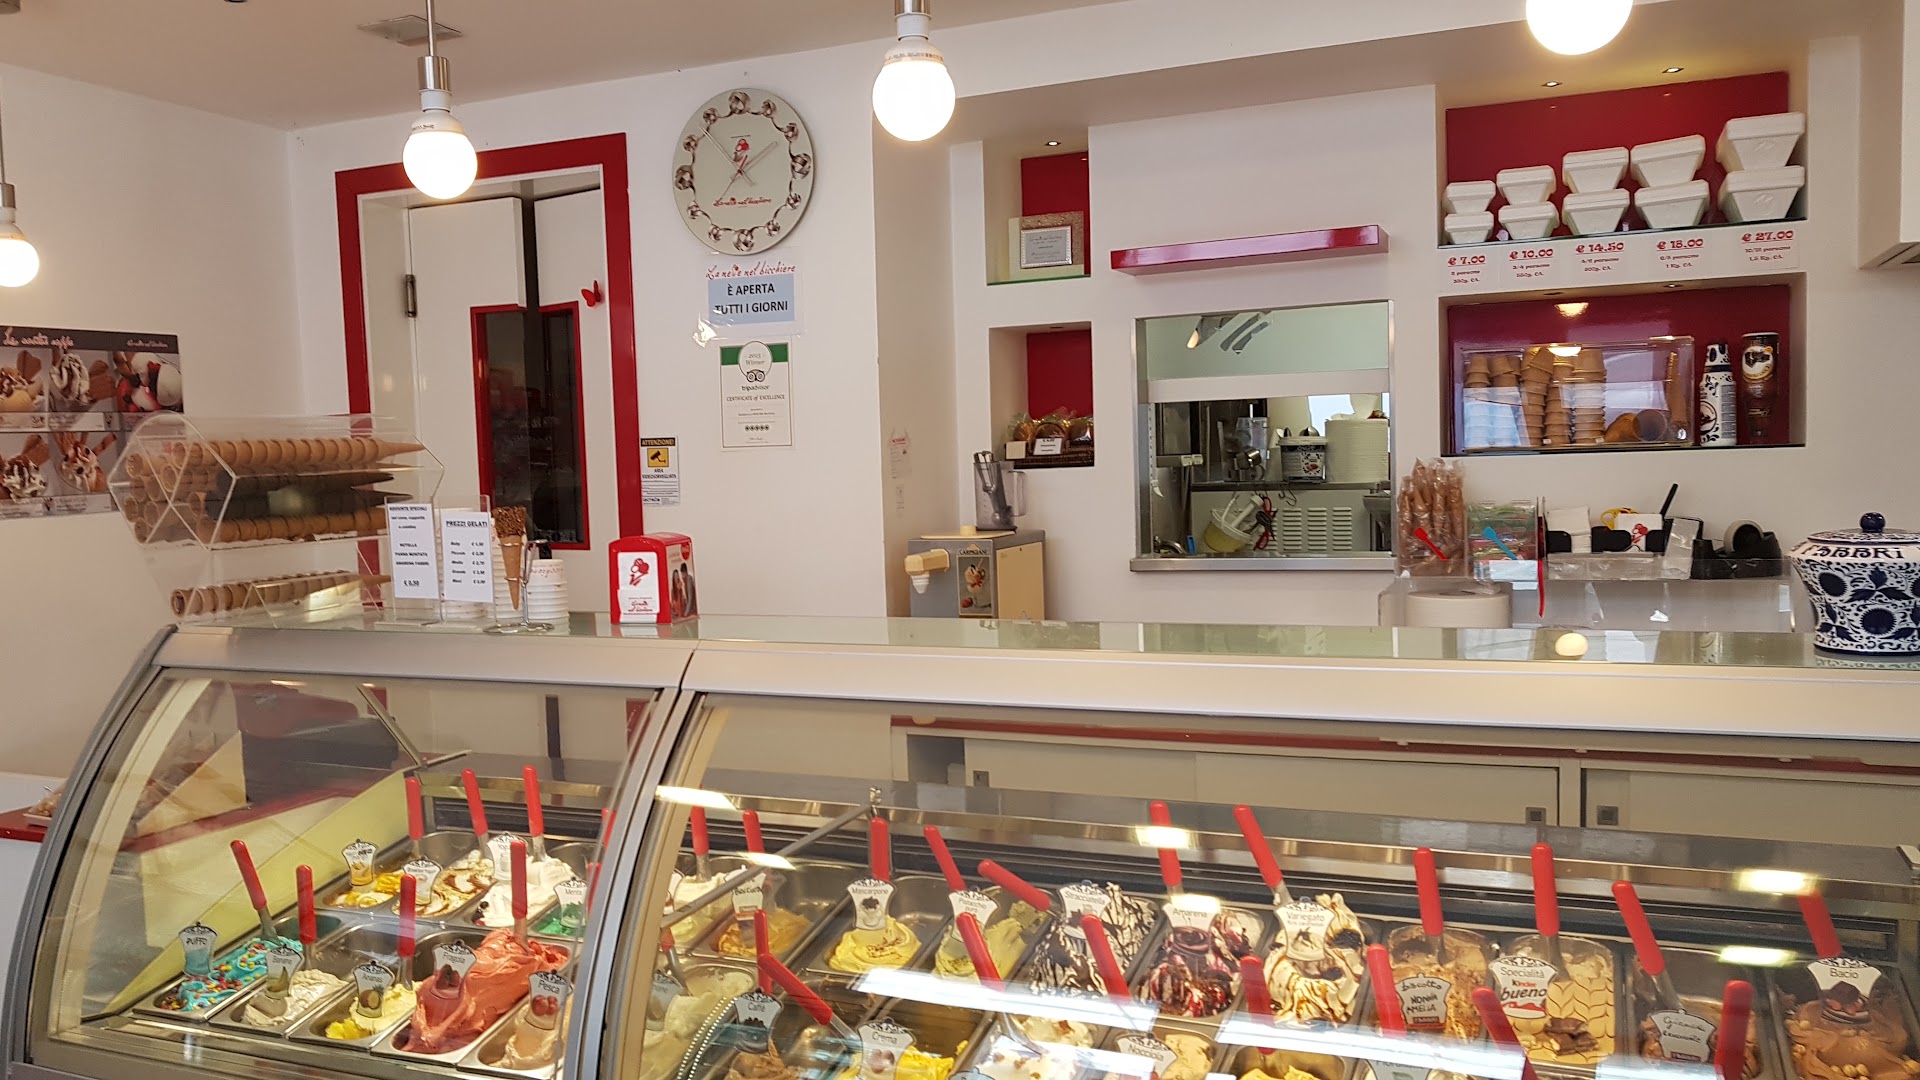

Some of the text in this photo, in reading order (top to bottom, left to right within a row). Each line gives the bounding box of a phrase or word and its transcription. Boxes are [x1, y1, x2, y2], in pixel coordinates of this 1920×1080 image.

[1742, 230, 1794, 242] € 27.00
[1576, 242, 1624, 253] € 14.50
[1657, 239, 1704, 250] € 18.00
[1510, 249, 1554, 260] € 10.00
[1448, 256, 1486, 266] € 7.00
[706, 261, 796, 280] La neve nel bicchiere
[728, 283, 775, 296] È APERTA
[714, 301, 788, 315] TUTTI I GIORNI
[852, 887, 888, 896] Mascarpone
[958, 898, 988, 910] Pistacchio
[1172, 907, 1208, 918] Amarena
[1286, 912, 1325, 922] Variegato
[273, 956, 292, 964] Banana
[443, 951, 466, 964] Fragola
[362, 973, 383, 983] Ananas
[1500, 967, 1544, 978] Specialità
[1830, 968, 1859, 979] Bacio
[538, 980, 560, 994] Pesca
[1501, 987, 1547, 1001] bueno
[872, 1032, 897, 1044] Crema
[1128, 1044, 1164, 1062] Nocciola
